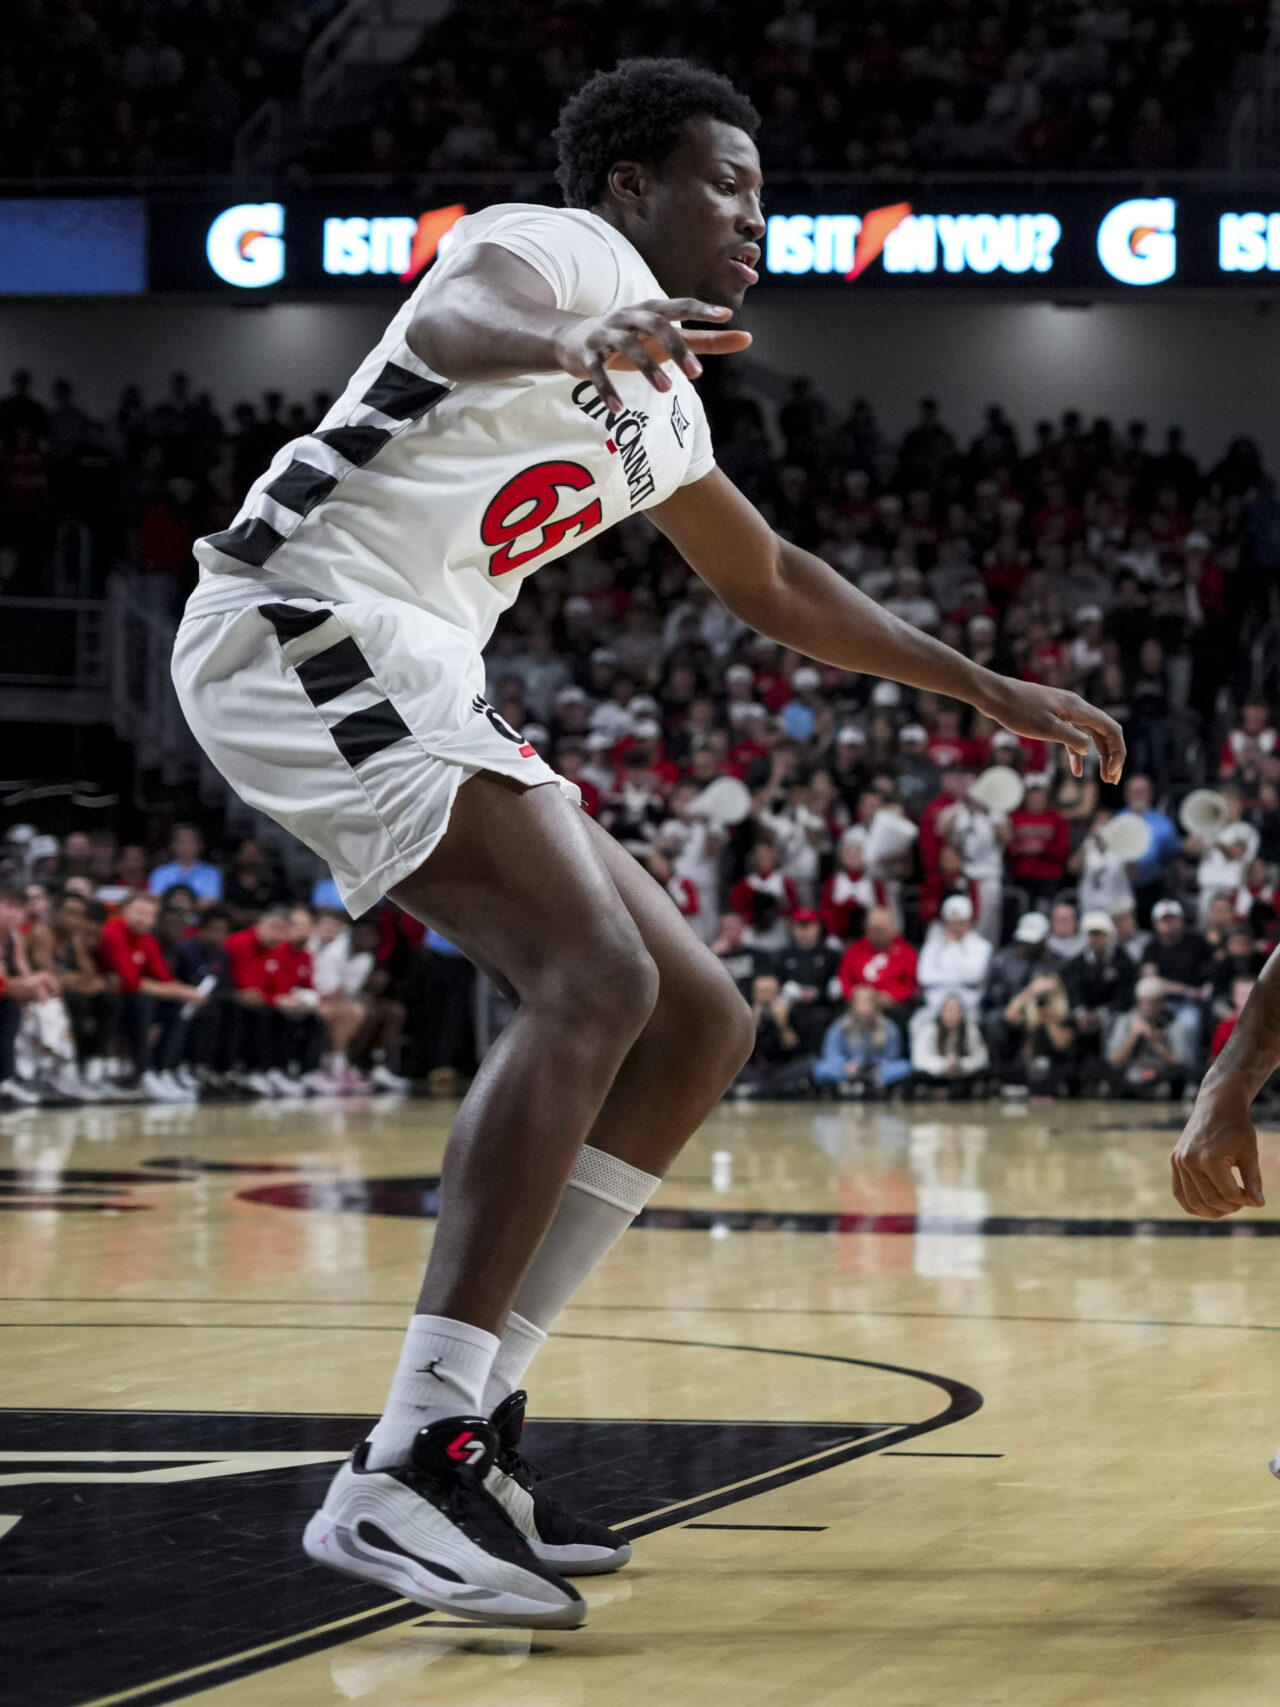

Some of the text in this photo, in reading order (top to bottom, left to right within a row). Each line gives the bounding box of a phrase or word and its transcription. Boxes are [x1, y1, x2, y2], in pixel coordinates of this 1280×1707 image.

[206, 203, 285, 288] G
[938, 213, 1061, 273] YOU?
[1097, 198, 1177, 285] G
[571, 380, 656, 510] CINCINNATI
[480, 460, 602, 577] 65
